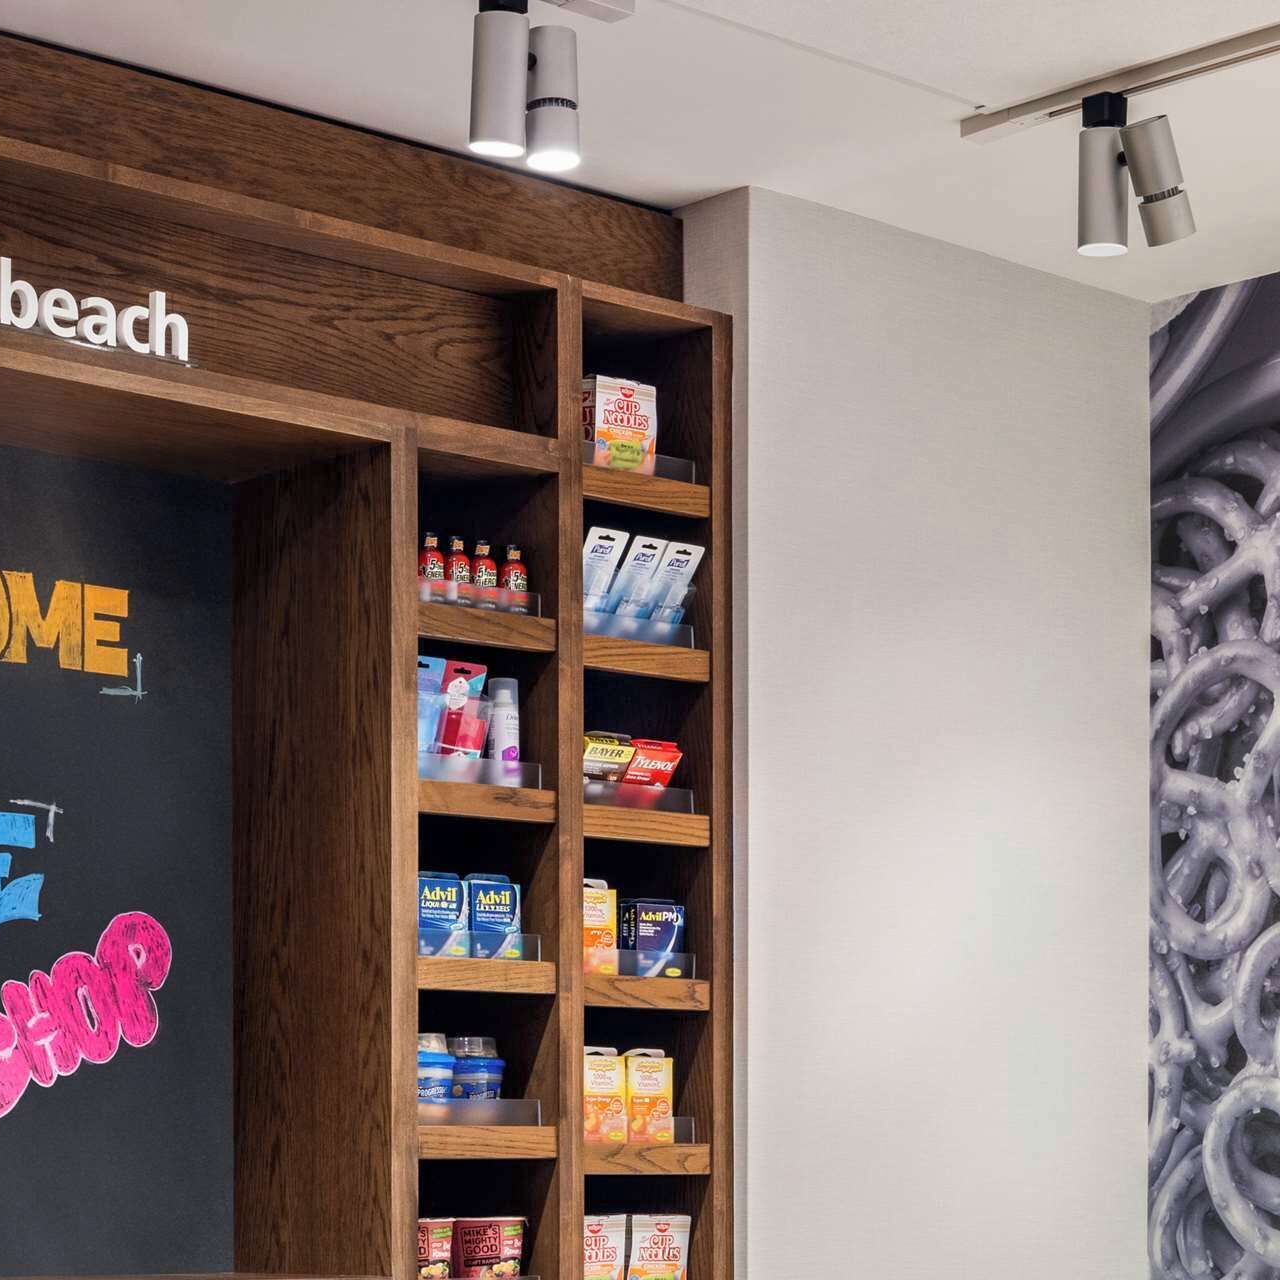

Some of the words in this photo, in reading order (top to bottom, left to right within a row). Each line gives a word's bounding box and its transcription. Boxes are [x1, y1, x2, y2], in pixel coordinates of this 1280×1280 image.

[614, 398, 640, 415] CUP
[604, 409, 650, 430] NOODLES
[588, 745, 624, 759] BAYER
[633, 755, 676, 771] TYLENOL
[420, 885, 457, 902] Advil
[476, 890, 511, 907] Advil
[463, 1223, 498, 1238] MIKE'S
[463, 1235, 498, 1246] MIGHTY
[464, 1245, 499, 1256] GOOD
